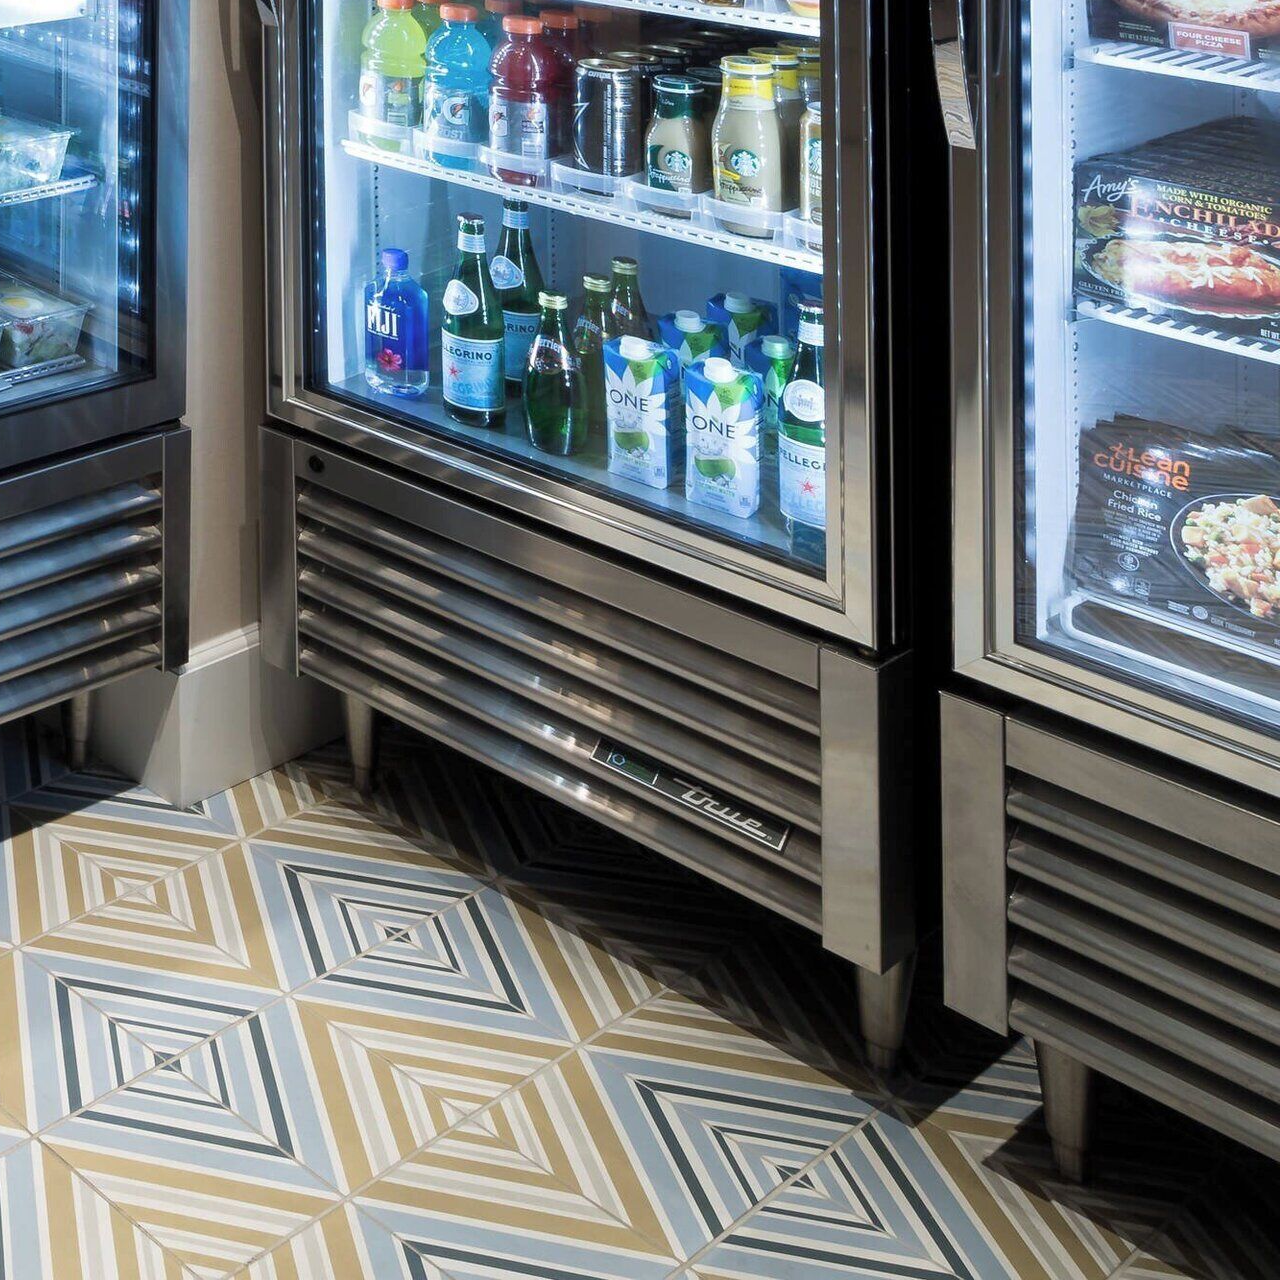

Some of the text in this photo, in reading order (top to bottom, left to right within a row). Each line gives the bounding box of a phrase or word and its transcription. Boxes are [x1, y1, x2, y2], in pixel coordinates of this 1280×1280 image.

[1177, 30, 1203, 40] FOUR
[1205, 34, 1243, 47] CHEESE
[1195, 39, 1225, 50] PIZZA
[1082, 174, 1139, 204] Amy's
[1157, 184, 1273, 215] MADE WITH ORGANIC
[1130, 197, 1280, 240] ENCHILAD
[1162, 193, 1268, 222] CORN & TOMATOES
[1170, 218, 1260, 245] CHEESE
[610, 388, 649, 413] ONE
[692, 414, 736, 440] ONE
[1103, 473, 1173, 500] MARKETPLACE
[1108, 498, 1163, 523] Fried Rice
[1114, 490, 1159, 511] Chicken
